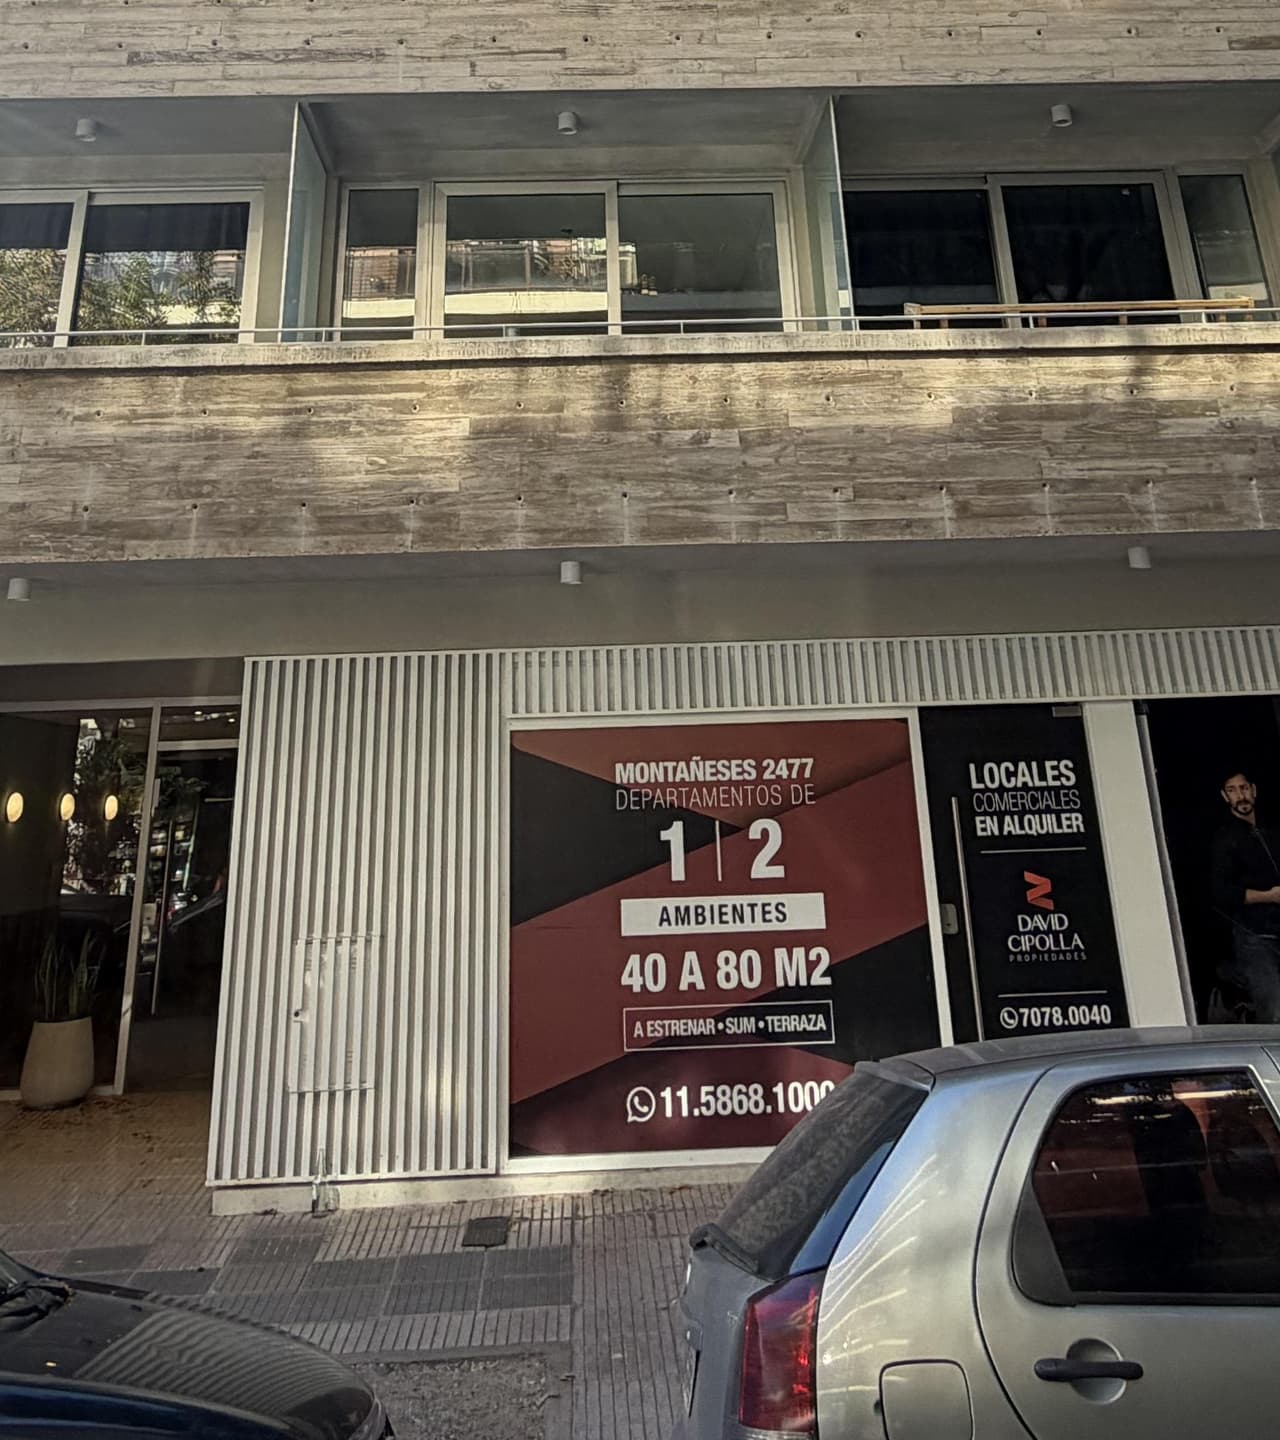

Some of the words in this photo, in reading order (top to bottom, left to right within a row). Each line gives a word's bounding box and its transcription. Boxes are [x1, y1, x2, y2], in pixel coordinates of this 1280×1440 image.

[615, 756, 757, 784] MONTAÑESES
[762, 758, 814, 780] 2477
[969, 760, 1076, 789] LOCALES
[616, 784, 782, 810] DEPARTAMENTOS
[791, 783, 817, 805] DE
[973, 789, 1081, 812] COMERCIALES
[975, 816, 1000, 836] EN
[1003, 812, 1085, 836] ALQUILER
[660, 820, 686, 882] 1
[748, 818, 785, 880] 2
[658, 901, 788, 928] AMBIENTES
[1017, 913, 1069, 932] DAVID
[1007, 933, 1085, 952] CIPOLLA
[1009, 951, 1087, 962] PROPIEDADES
[621, 953, 667, 993] 40
[678, 951, 705, 991] A
[716, 948, 762, 990] 80
[774, 946, 832, 988] M2
[633, 1021, 644, 1038] A
[646, 1017, 716, 1037] ESTRENAR
[725, 1016, 756, 1034] SUM
[766, 1013, 827, 1033] TERRAZA
[1020, 1005, 1112, 1027] 7078.0040
